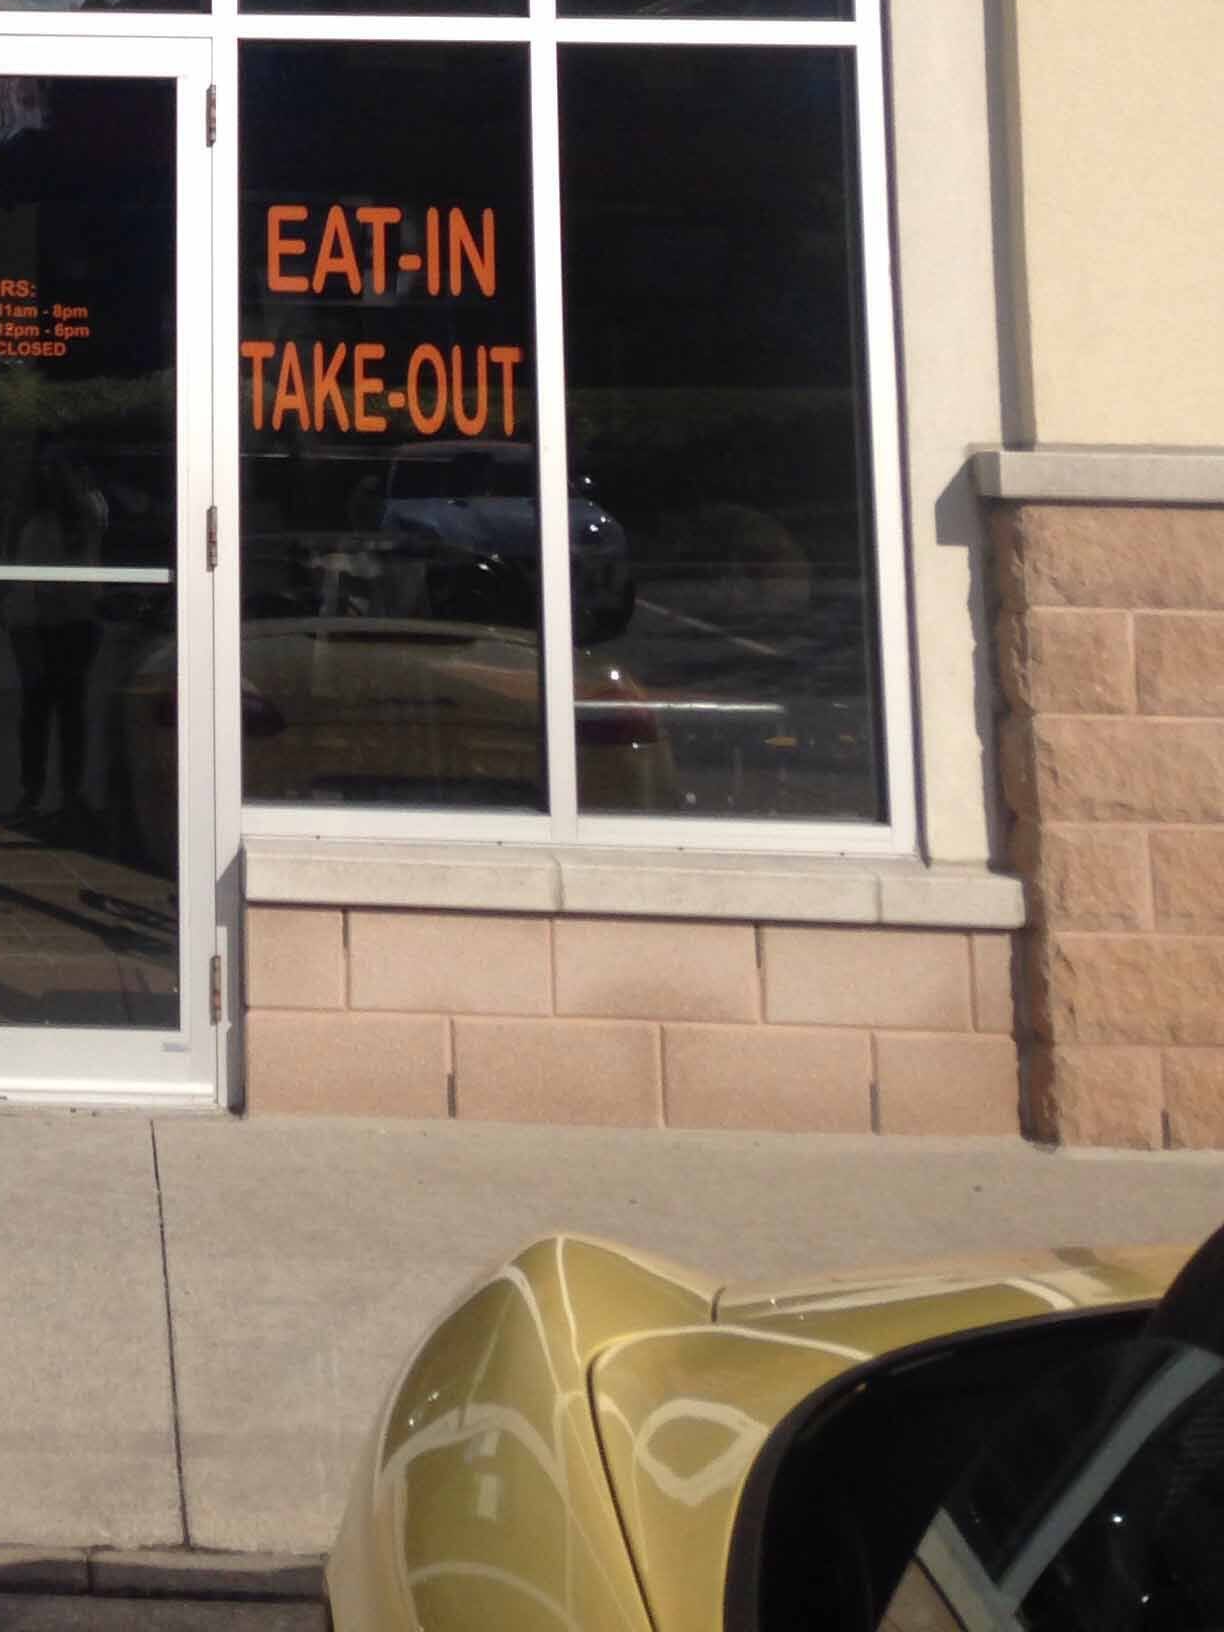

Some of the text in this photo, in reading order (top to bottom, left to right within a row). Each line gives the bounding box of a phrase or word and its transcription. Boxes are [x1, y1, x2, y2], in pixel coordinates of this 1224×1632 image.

[267, 205, 496, 297] EAT-IN
[52, 304, 88, 320] 8pm
[54, 324, 90, 340] 6pm
[240, 341, 522, 438] TAKE-OUT
